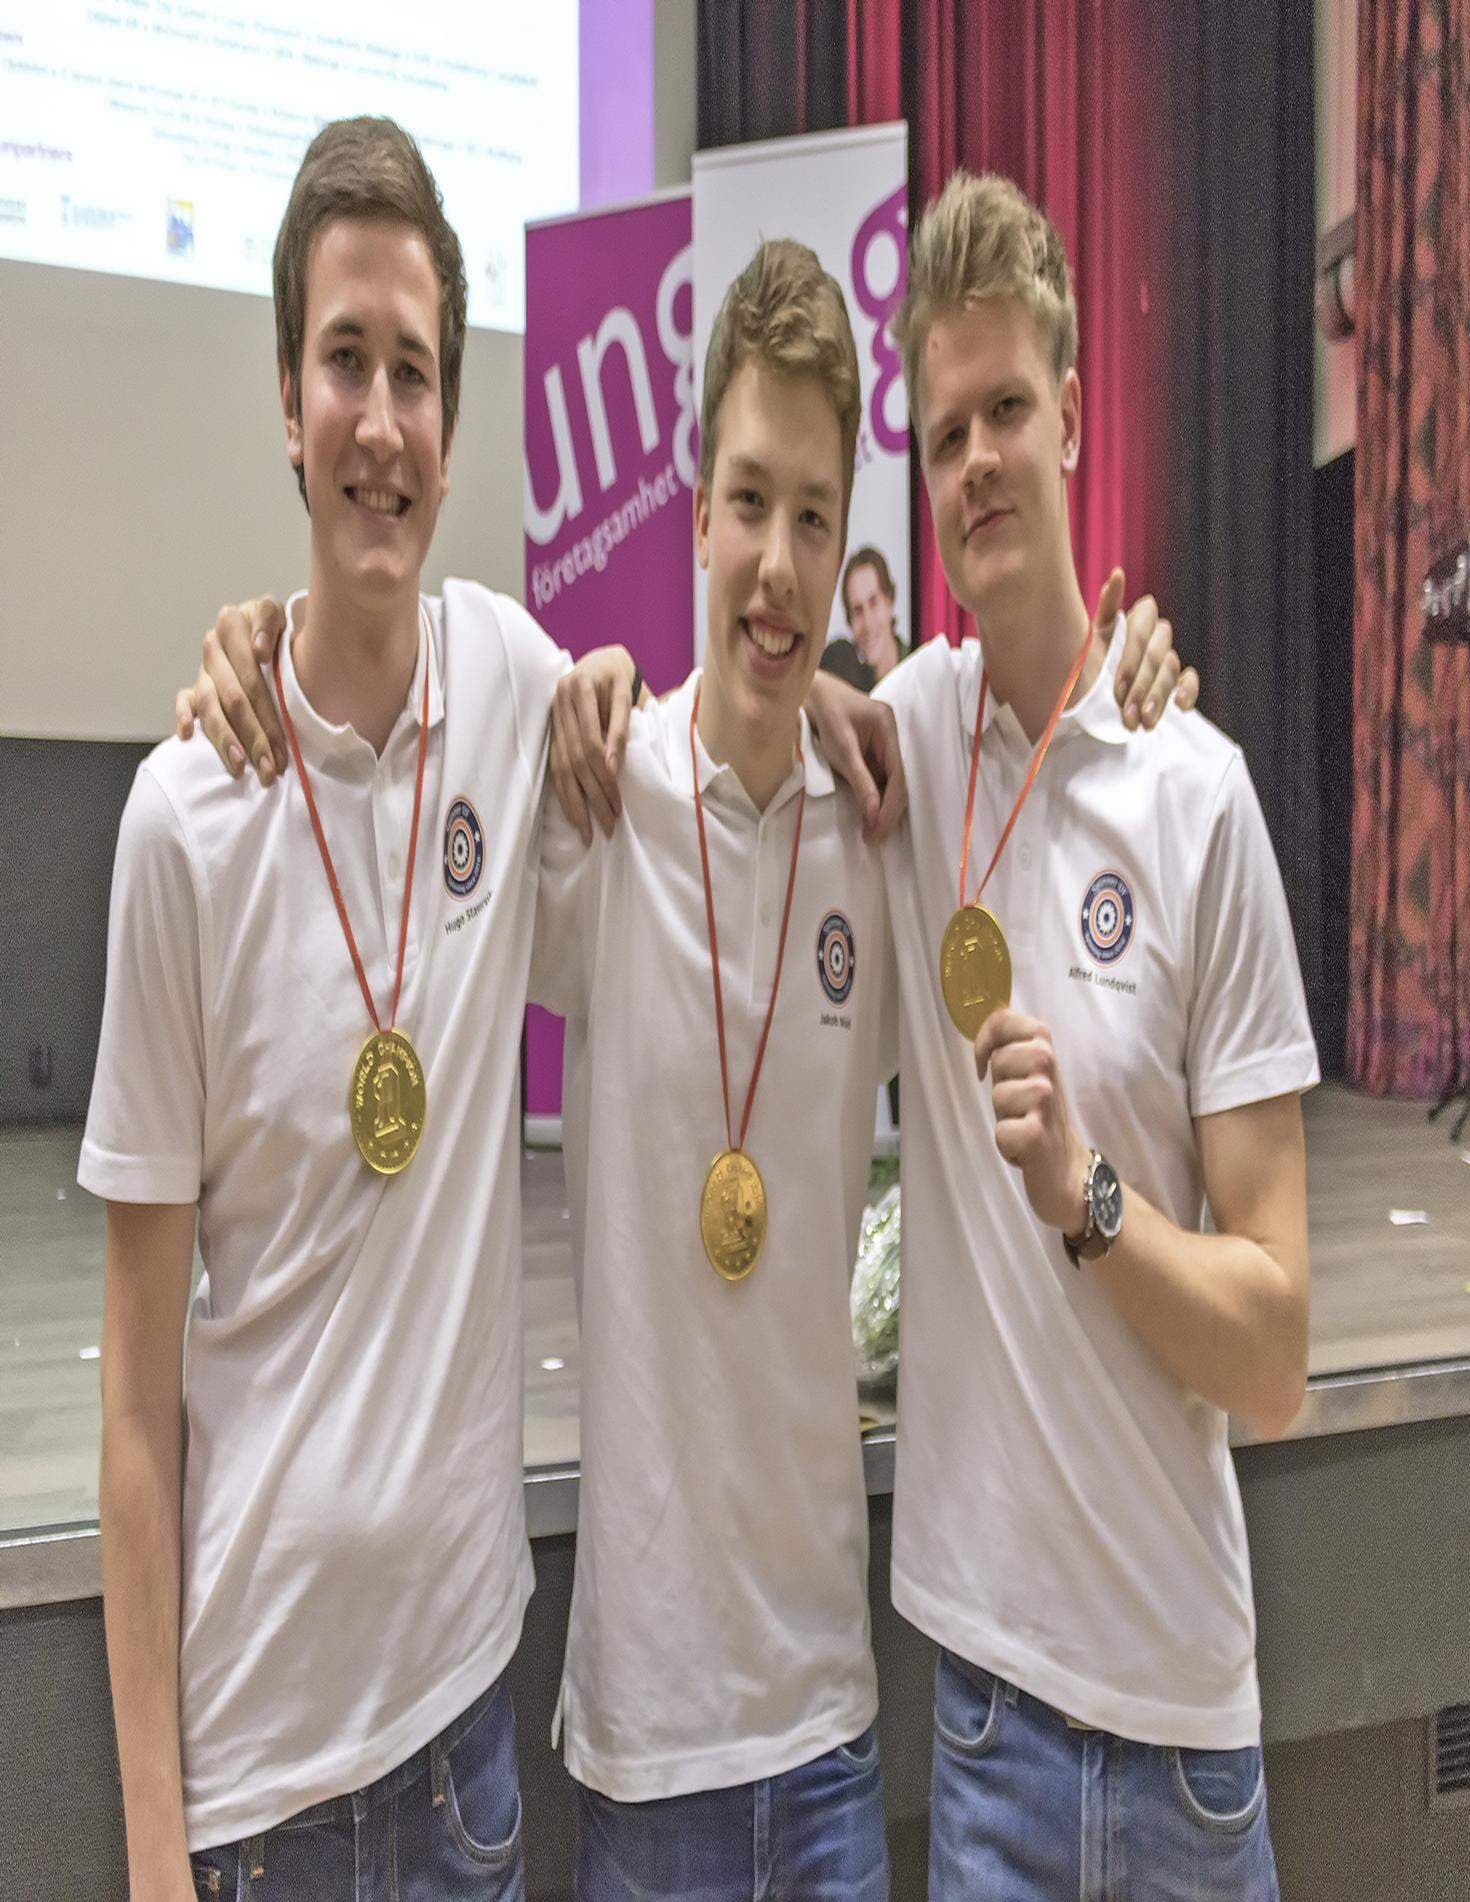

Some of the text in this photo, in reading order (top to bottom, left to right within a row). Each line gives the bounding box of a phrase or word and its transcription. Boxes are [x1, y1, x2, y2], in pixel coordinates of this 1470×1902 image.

[532, 463, 680, 611] företagsamhet
[444, 915, 466, 936] Hugo
[1068, 966, 1092, 983] Alfred
